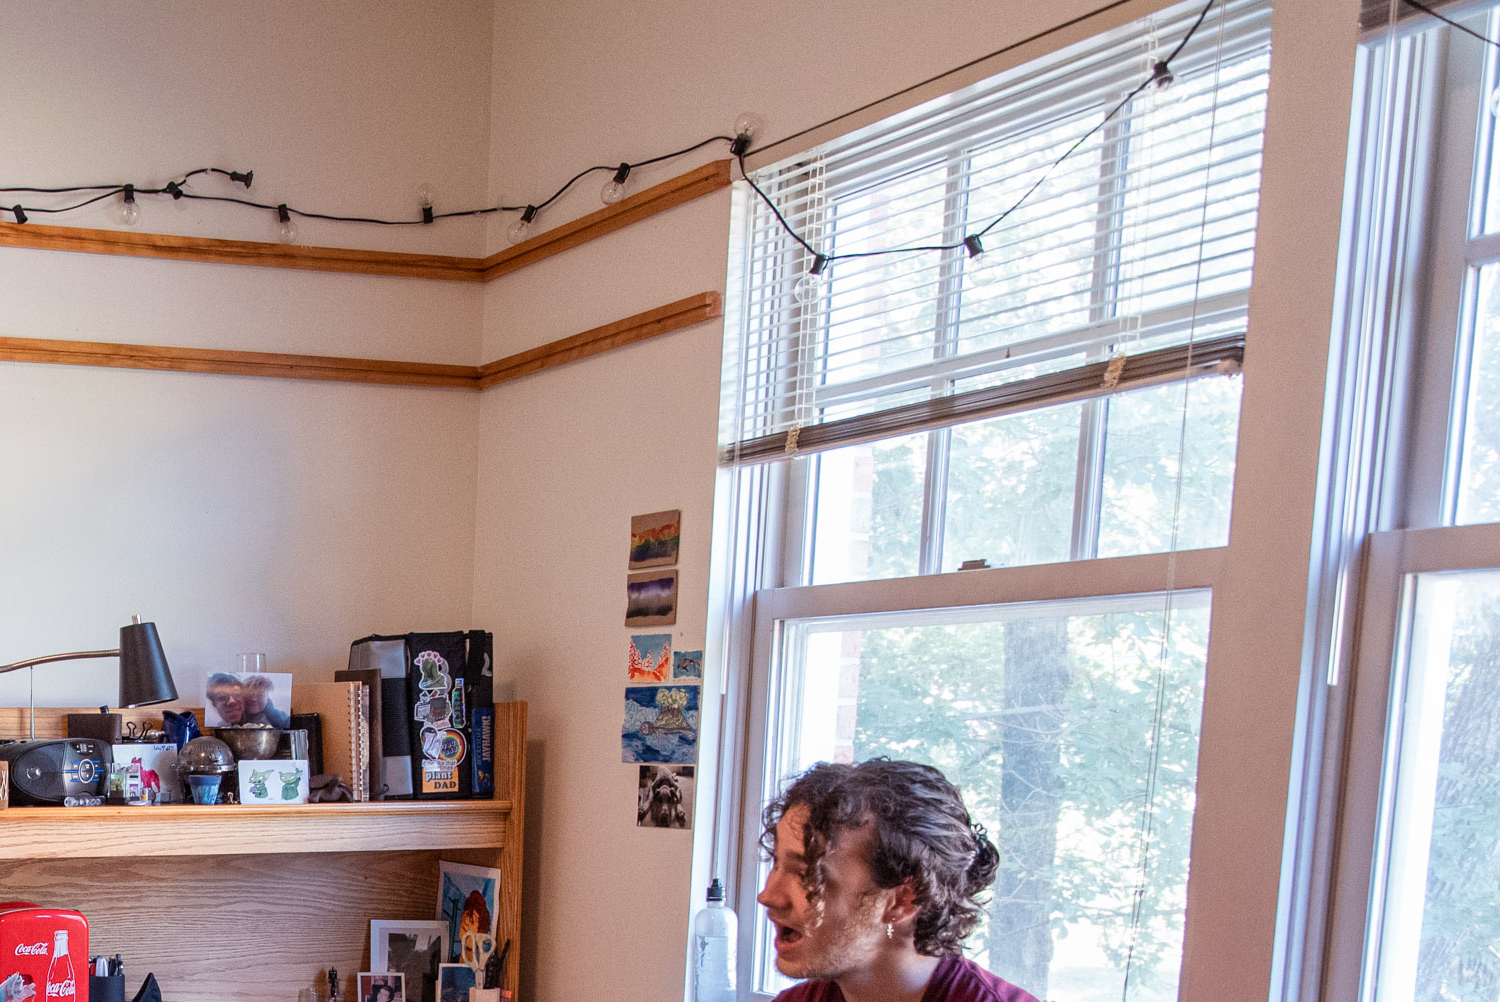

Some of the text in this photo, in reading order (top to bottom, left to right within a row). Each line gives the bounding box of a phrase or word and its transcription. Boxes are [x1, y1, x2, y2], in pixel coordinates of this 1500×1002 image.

[482, 715, 491, 762] JAYHAWK!
[425, 771, 453, 782] plant
[434, 781, 456, 790] DAD
[15, 942, 49, 956] Coca-Cola
